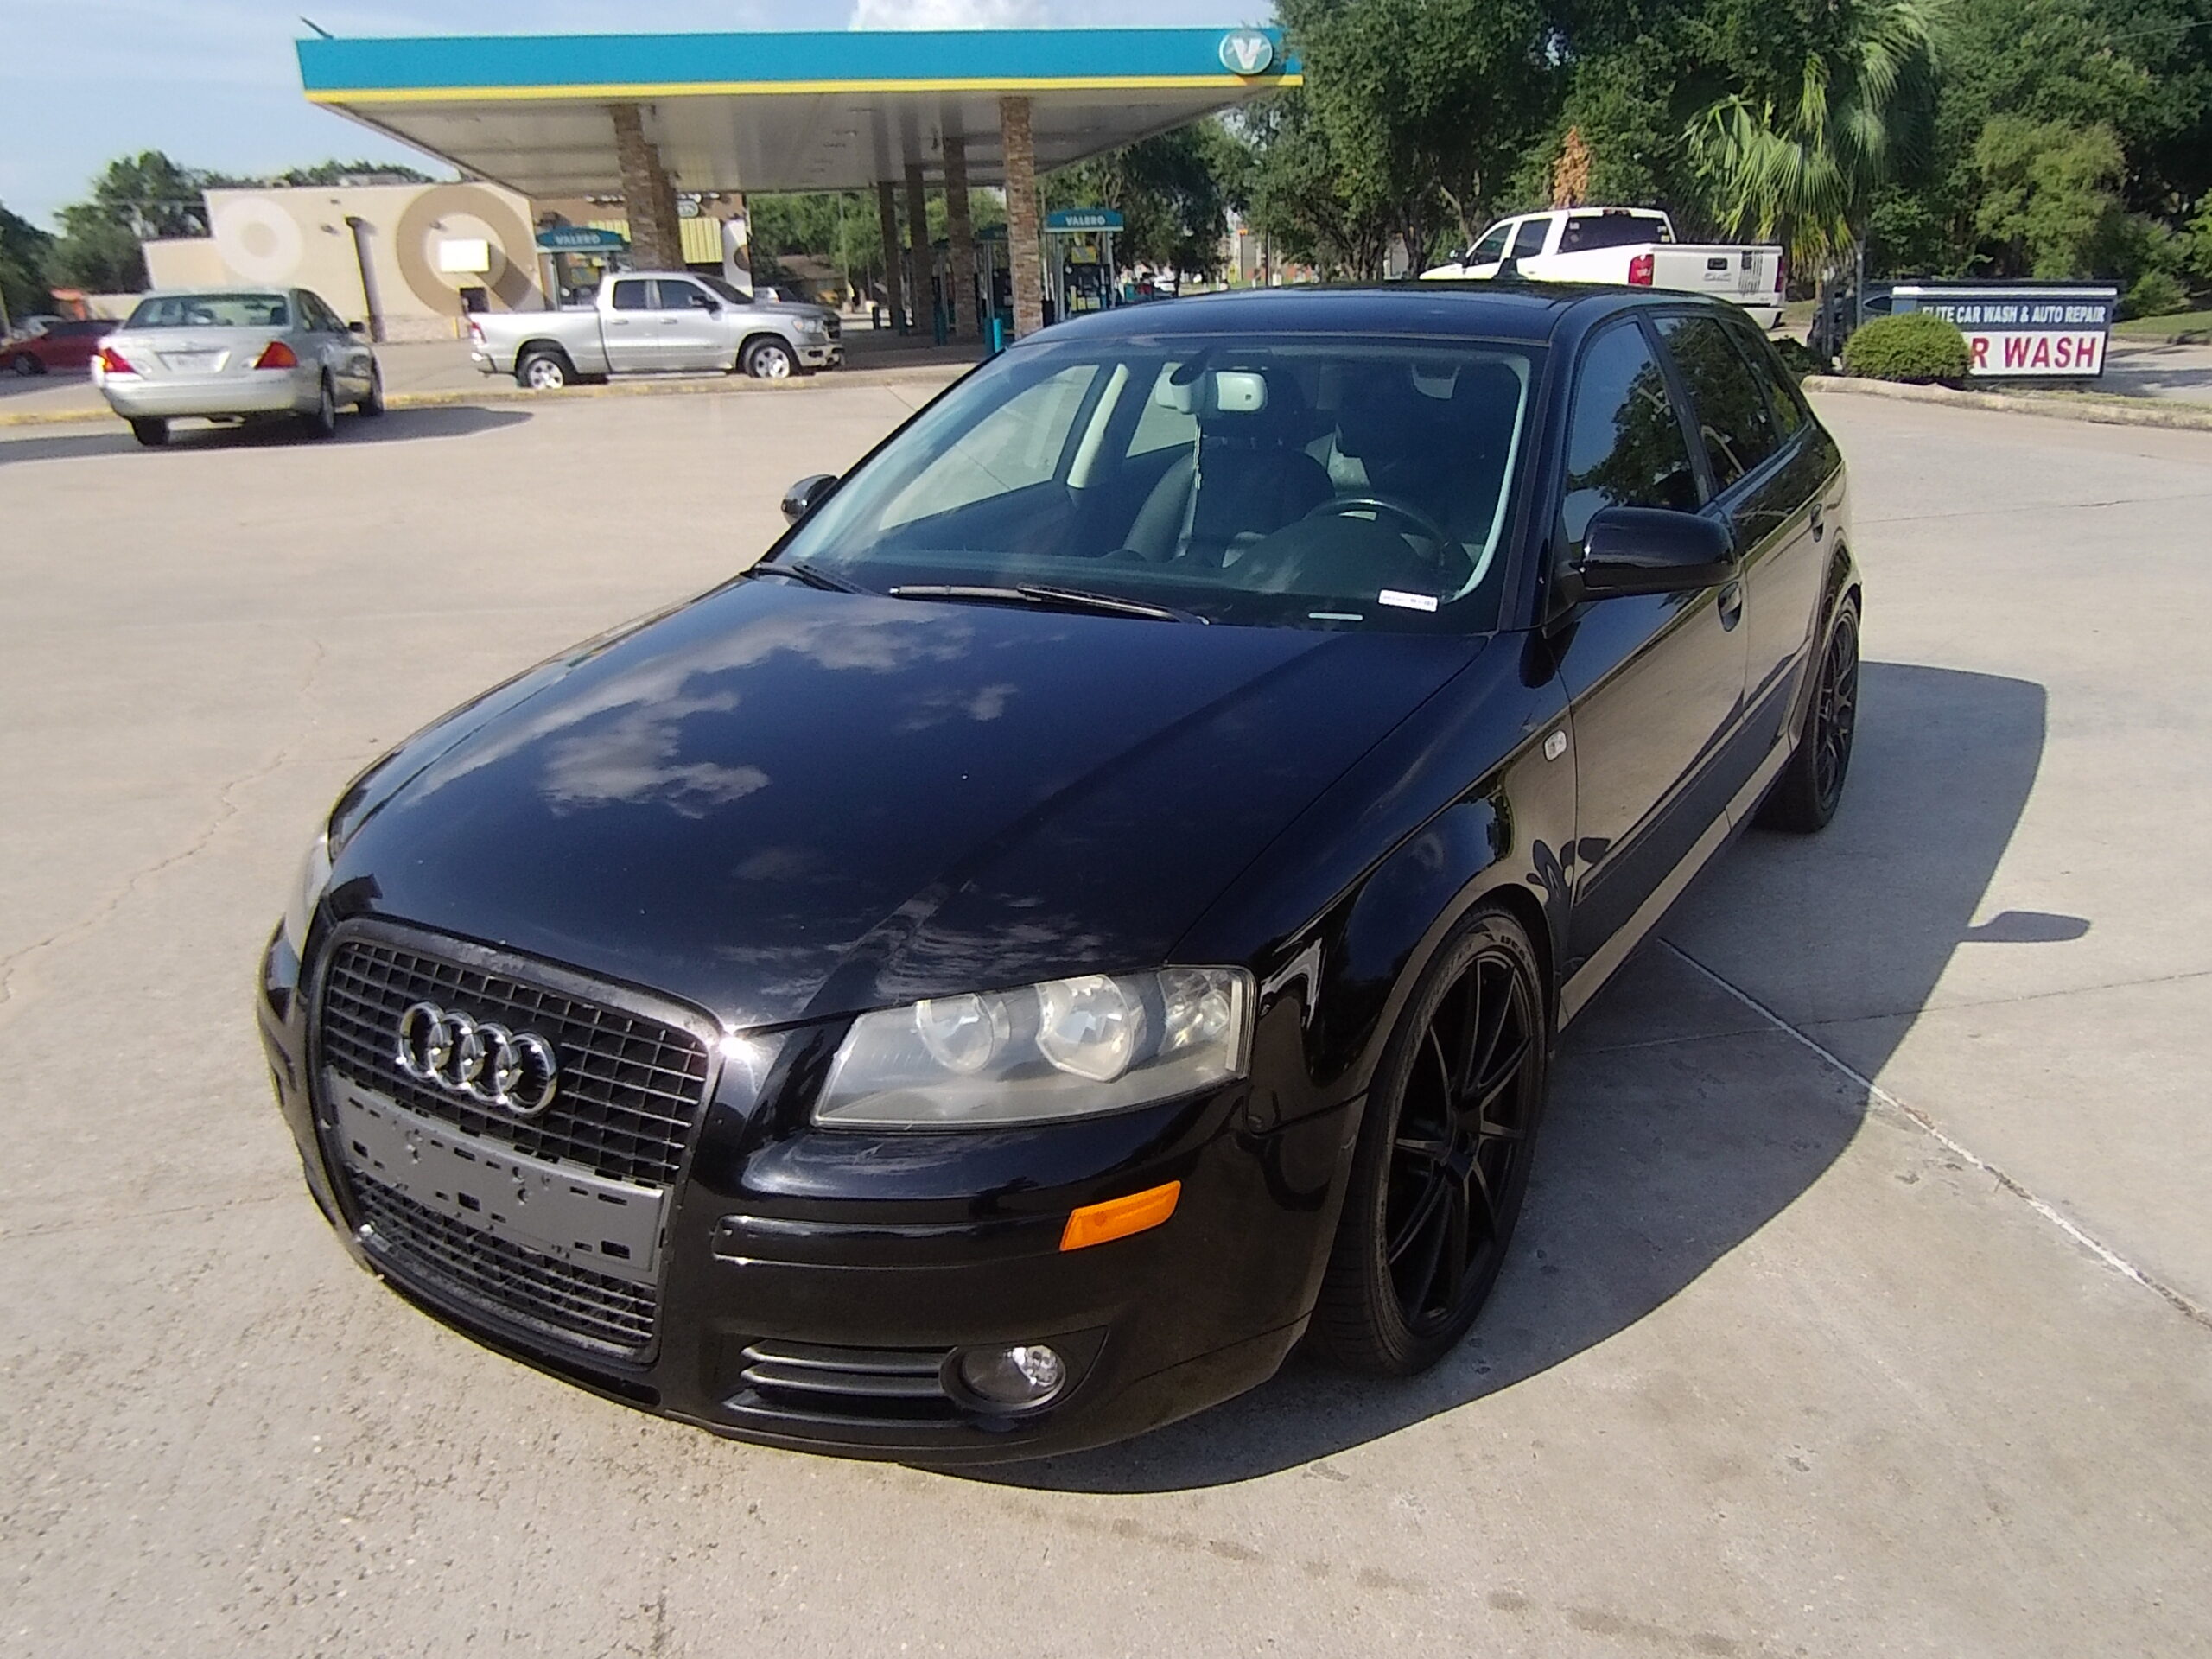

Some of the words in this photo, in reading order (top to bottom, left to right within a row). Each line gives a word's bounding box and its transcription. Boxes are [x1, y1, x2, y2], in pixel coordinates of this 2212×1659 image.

[1231, 38, 1262, 69] V
[1065, 215, 1106, 226] VALERO
[1956, 306, 1981, 323] CAR
[1983, 306, 2018, 323] WASH
[2019, 306, 2029, 323] &
[2031, 306, 2063, 323] AUTO
[2064, 306, 2106, 323] REPAIR
[2005, 337, 2096, 368] WASH
